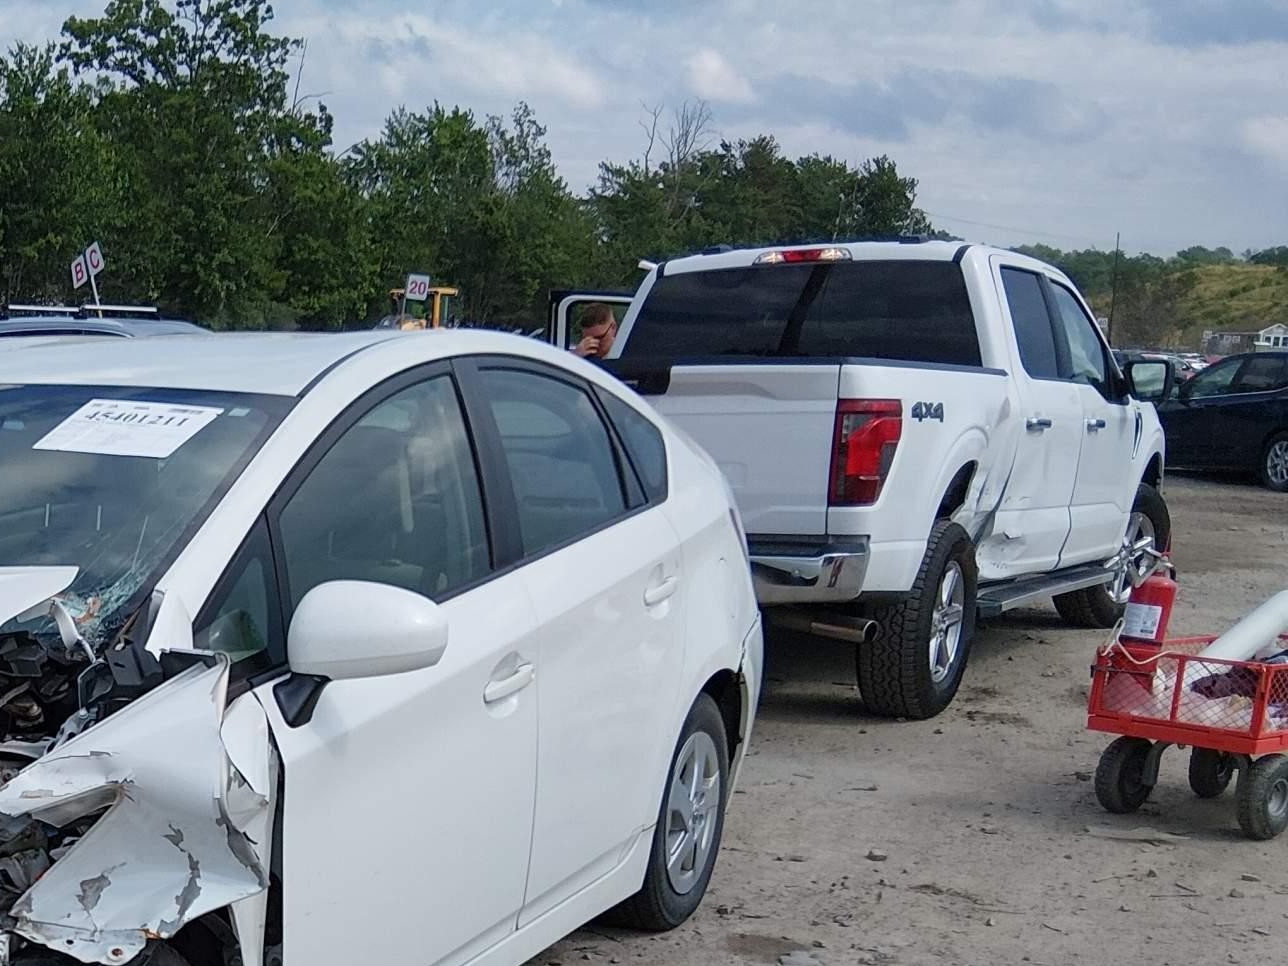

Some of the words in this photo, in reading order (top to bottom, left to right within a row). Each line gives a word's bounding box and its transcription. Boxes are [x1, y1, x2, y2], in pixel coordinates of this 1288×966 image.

[89, 249, 100, 269] C
[74, 262, 84, 284] B
[409, 280, 427, 296] 20
[85, 411, 189, 426] 45401211
